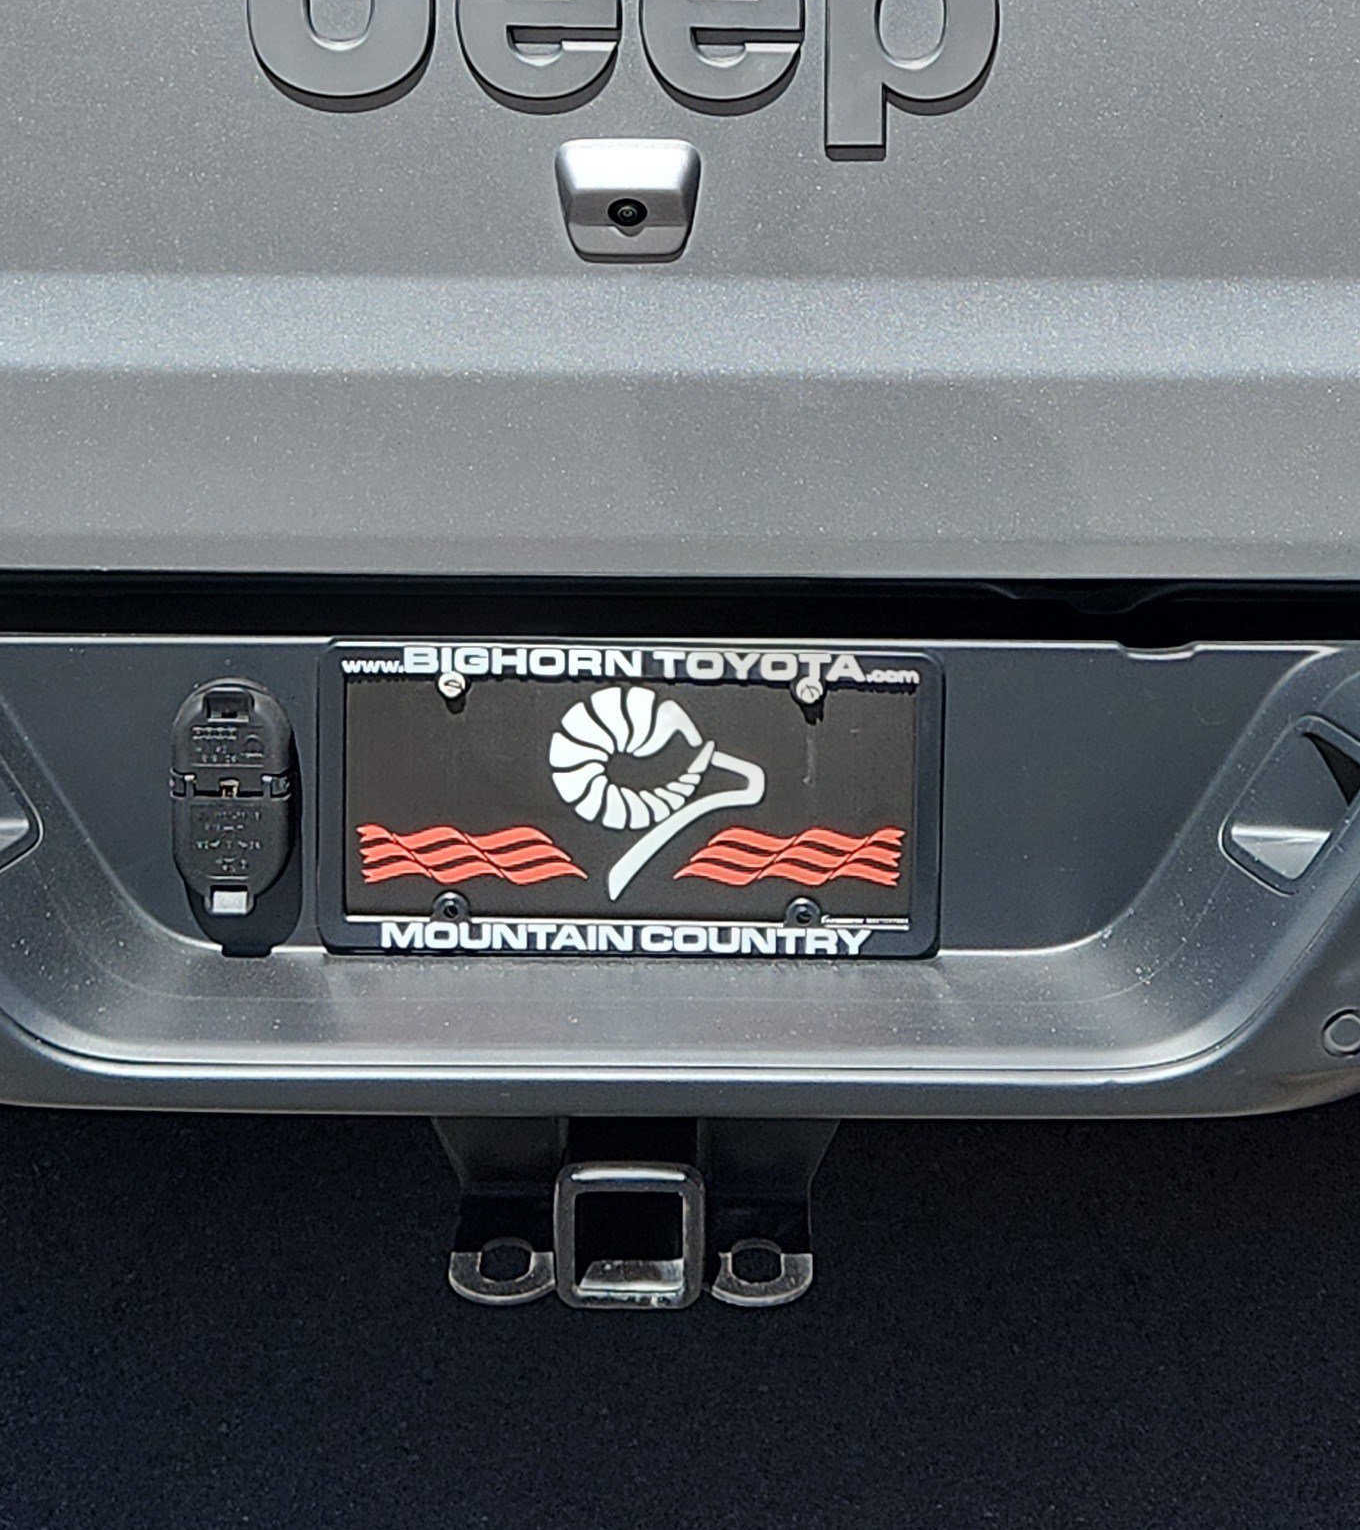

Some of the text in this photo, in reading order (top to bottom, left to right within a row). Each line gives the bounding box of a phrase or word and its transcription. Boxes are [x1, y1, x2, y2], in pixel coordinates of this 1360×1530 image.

[341, 645, 642, 678] www.BIGHORN
[380, 920, 872, 956] MOUNTAIN COUNTRY
